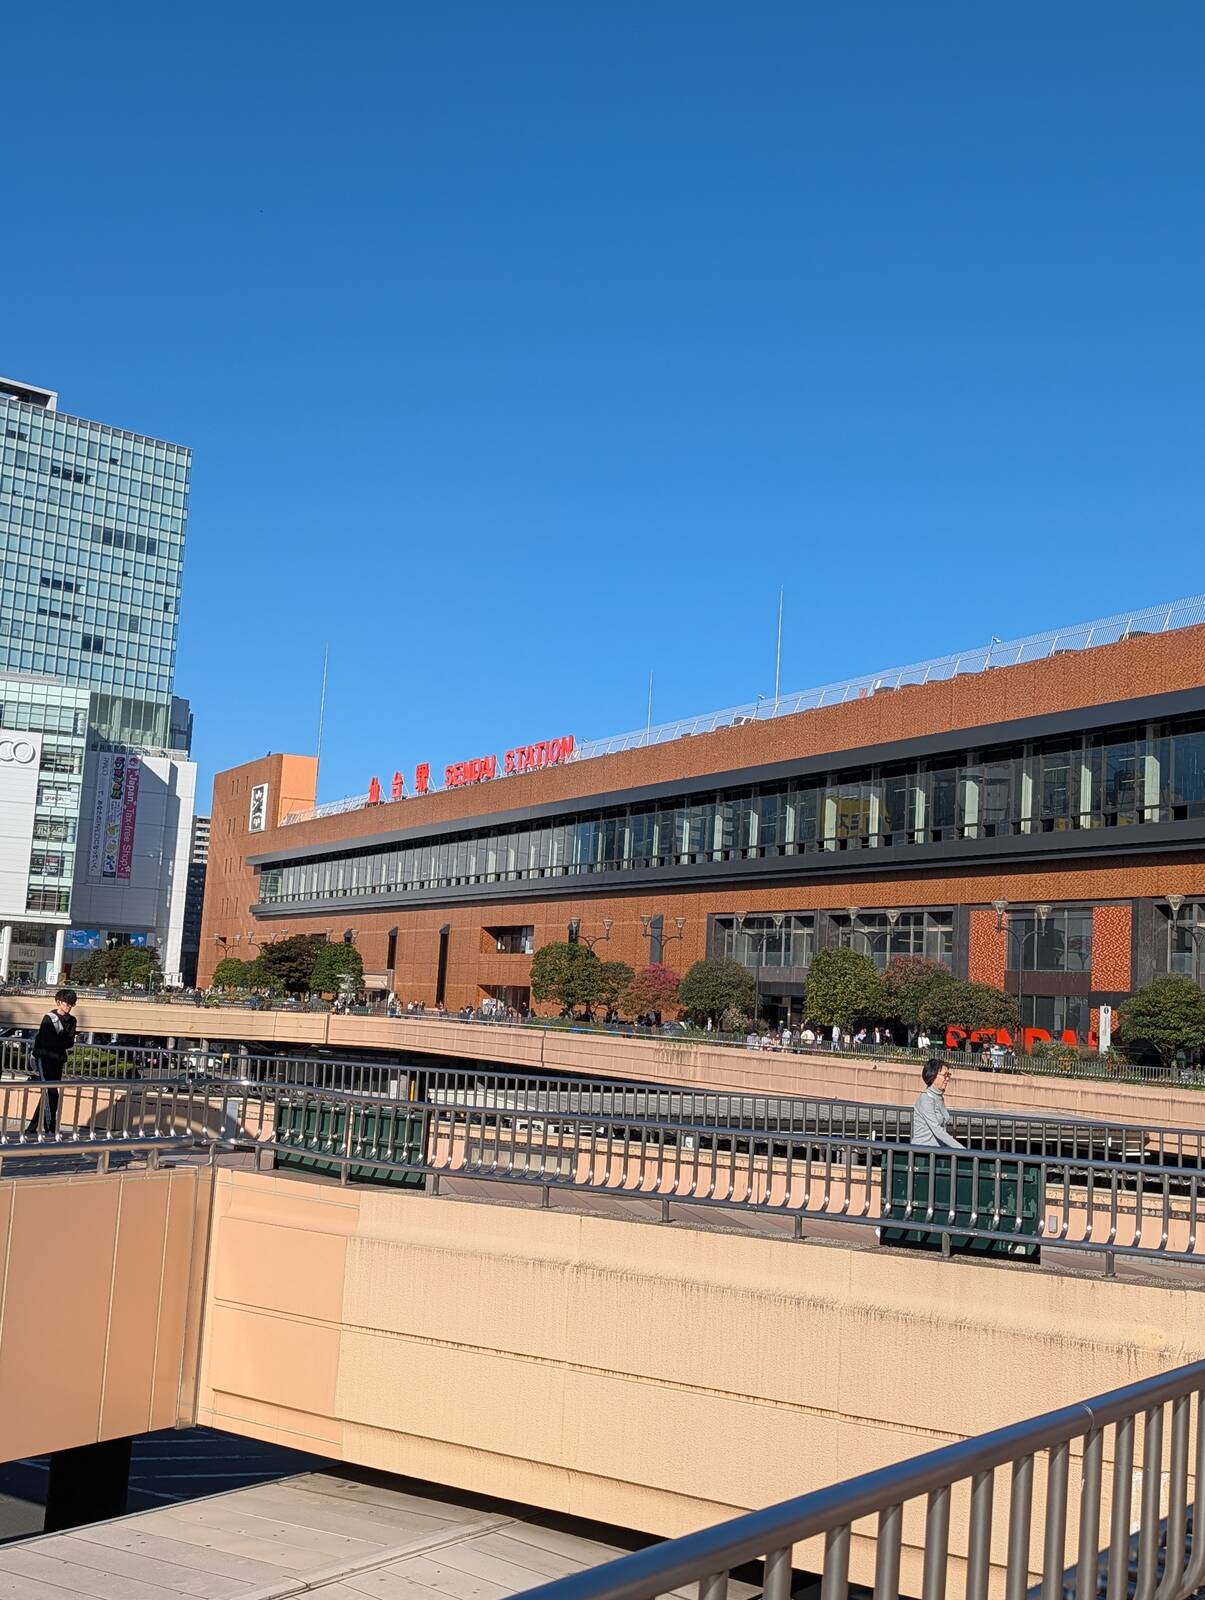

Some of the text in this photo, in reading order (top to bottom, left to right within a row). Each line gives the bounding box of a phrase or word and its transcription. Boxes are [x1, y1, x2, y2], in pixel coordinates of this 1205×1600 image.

[444, 736, 574, 785] SENDAI STATION
[119, 845, 131, 867] Shop
